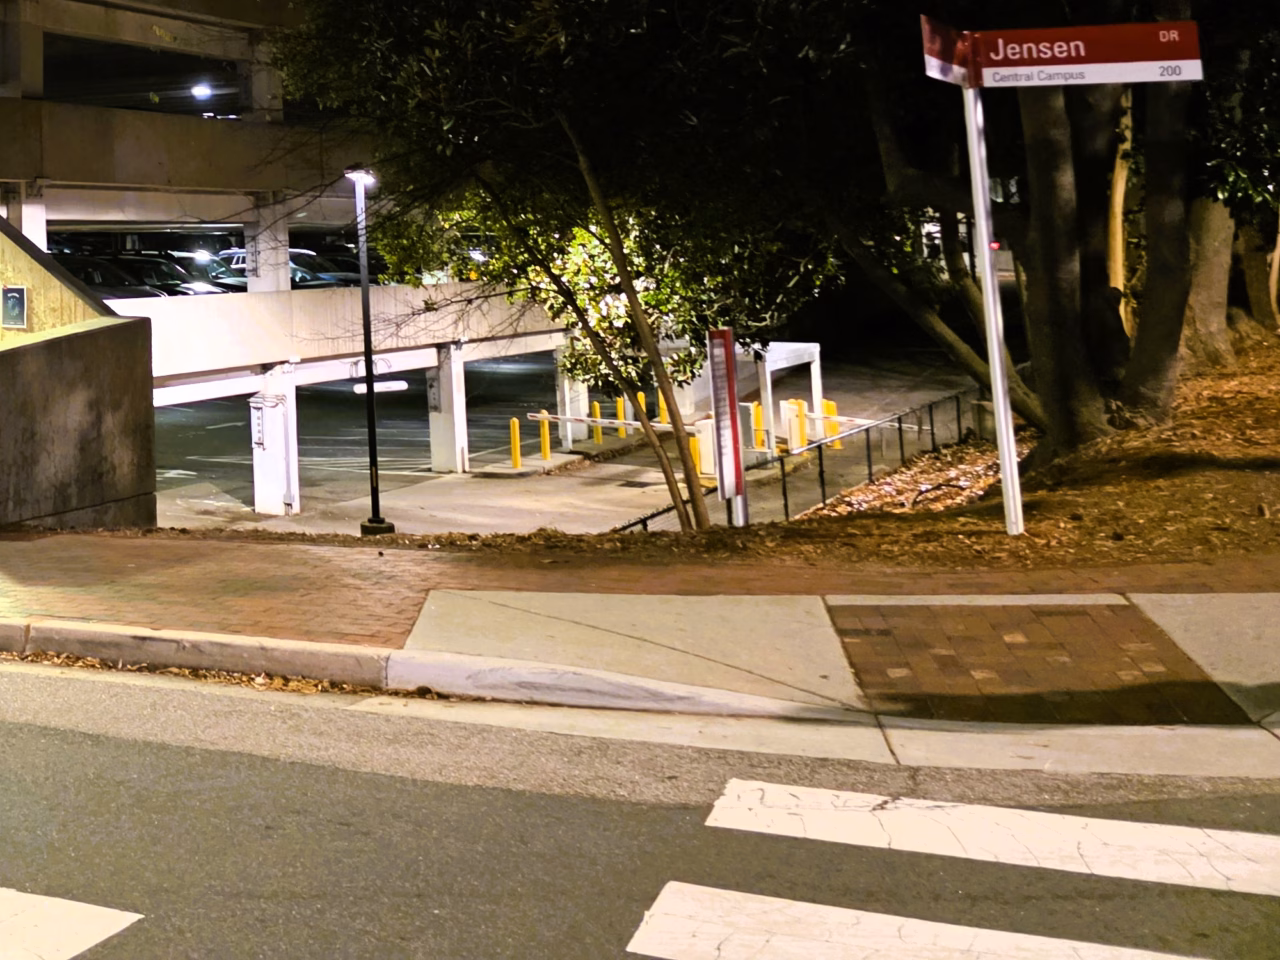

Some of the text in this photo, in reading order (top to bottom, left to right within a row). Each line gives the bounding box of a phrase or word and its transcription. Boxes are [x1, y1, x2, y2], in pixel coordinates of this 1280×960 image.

[989, 29, 1180, 60] Jensen DR
[992, 64, 1182, 83] Central Campus 200
